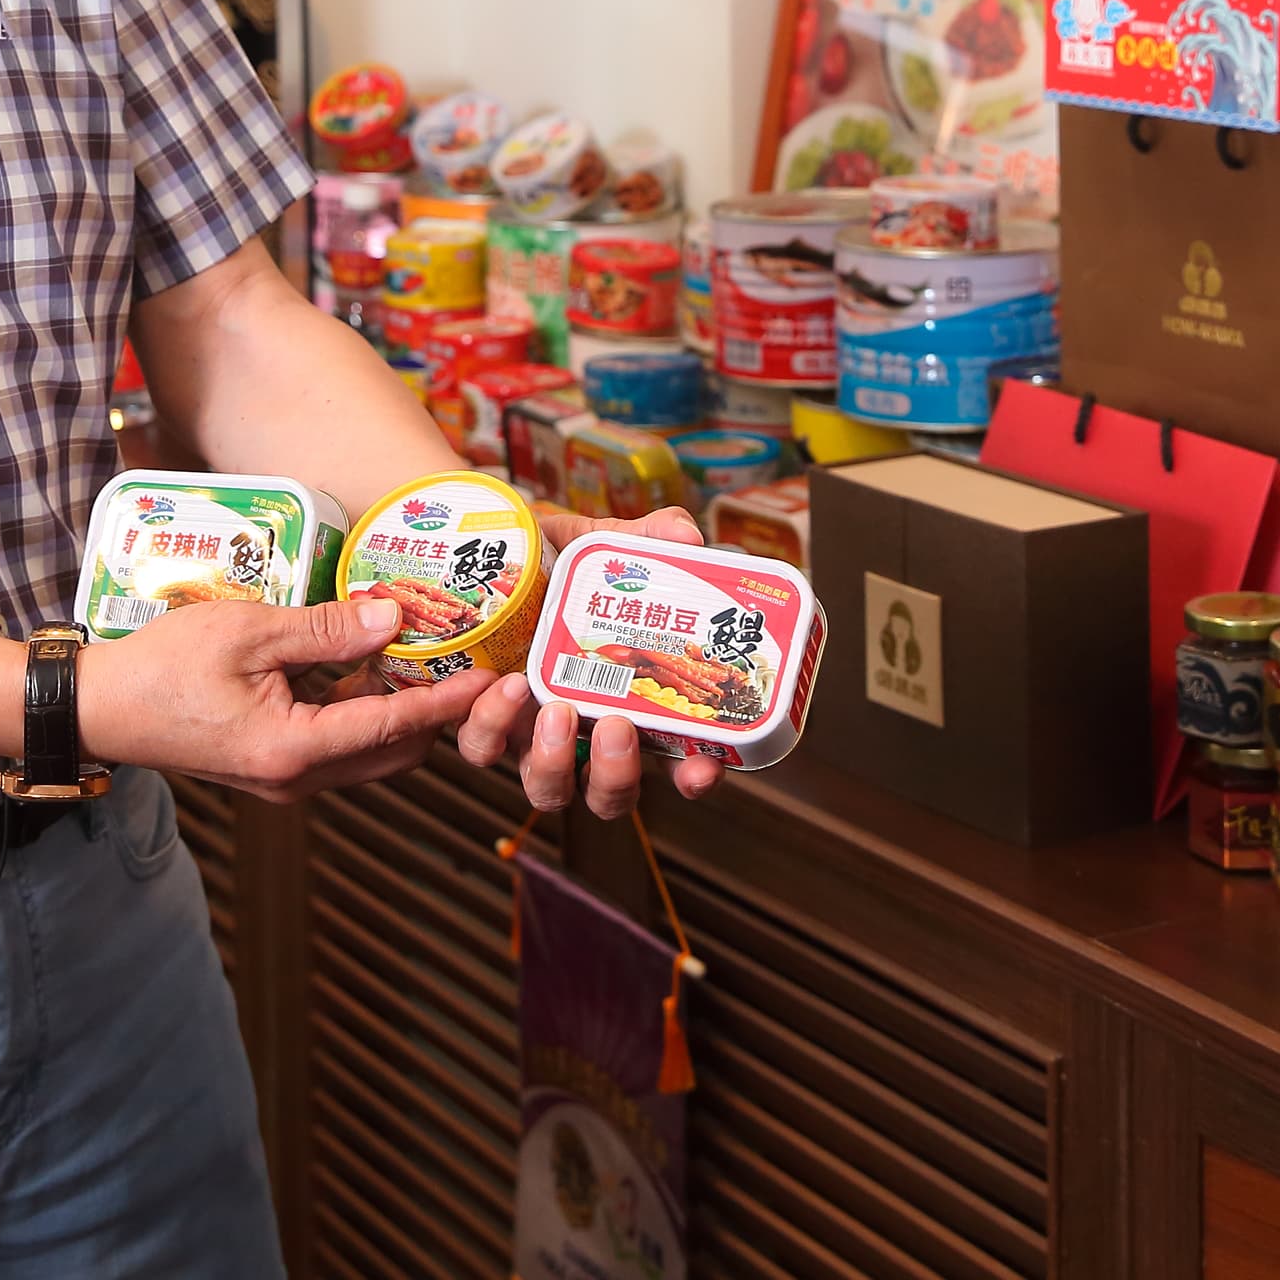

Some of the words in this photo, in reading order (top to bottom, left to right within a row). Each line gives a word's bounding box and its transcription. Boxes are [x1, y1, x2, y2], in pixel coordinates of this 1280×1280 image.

[366, 533, 450, 560] 麻辣花生
[361, 552, 400, 566] BRAISED
[402, 558, 418, 568] EEL
[422, 560, 445, 570] WITH
[377, 564, 403, 574] SPICY
[405, 567, 441, 578] PEANUT
[443, 538, 508, 596] 鰻
[585, 590, 701, 635] 紅燒樹豆
[591, 619, 637, 637] BRAISED
[638, 629, 658, 641] EEL
[660, 632, 687, 646] WITH
[703, 606, 764, 671] 鰻
[656, 642, 684, 657] PEAS
